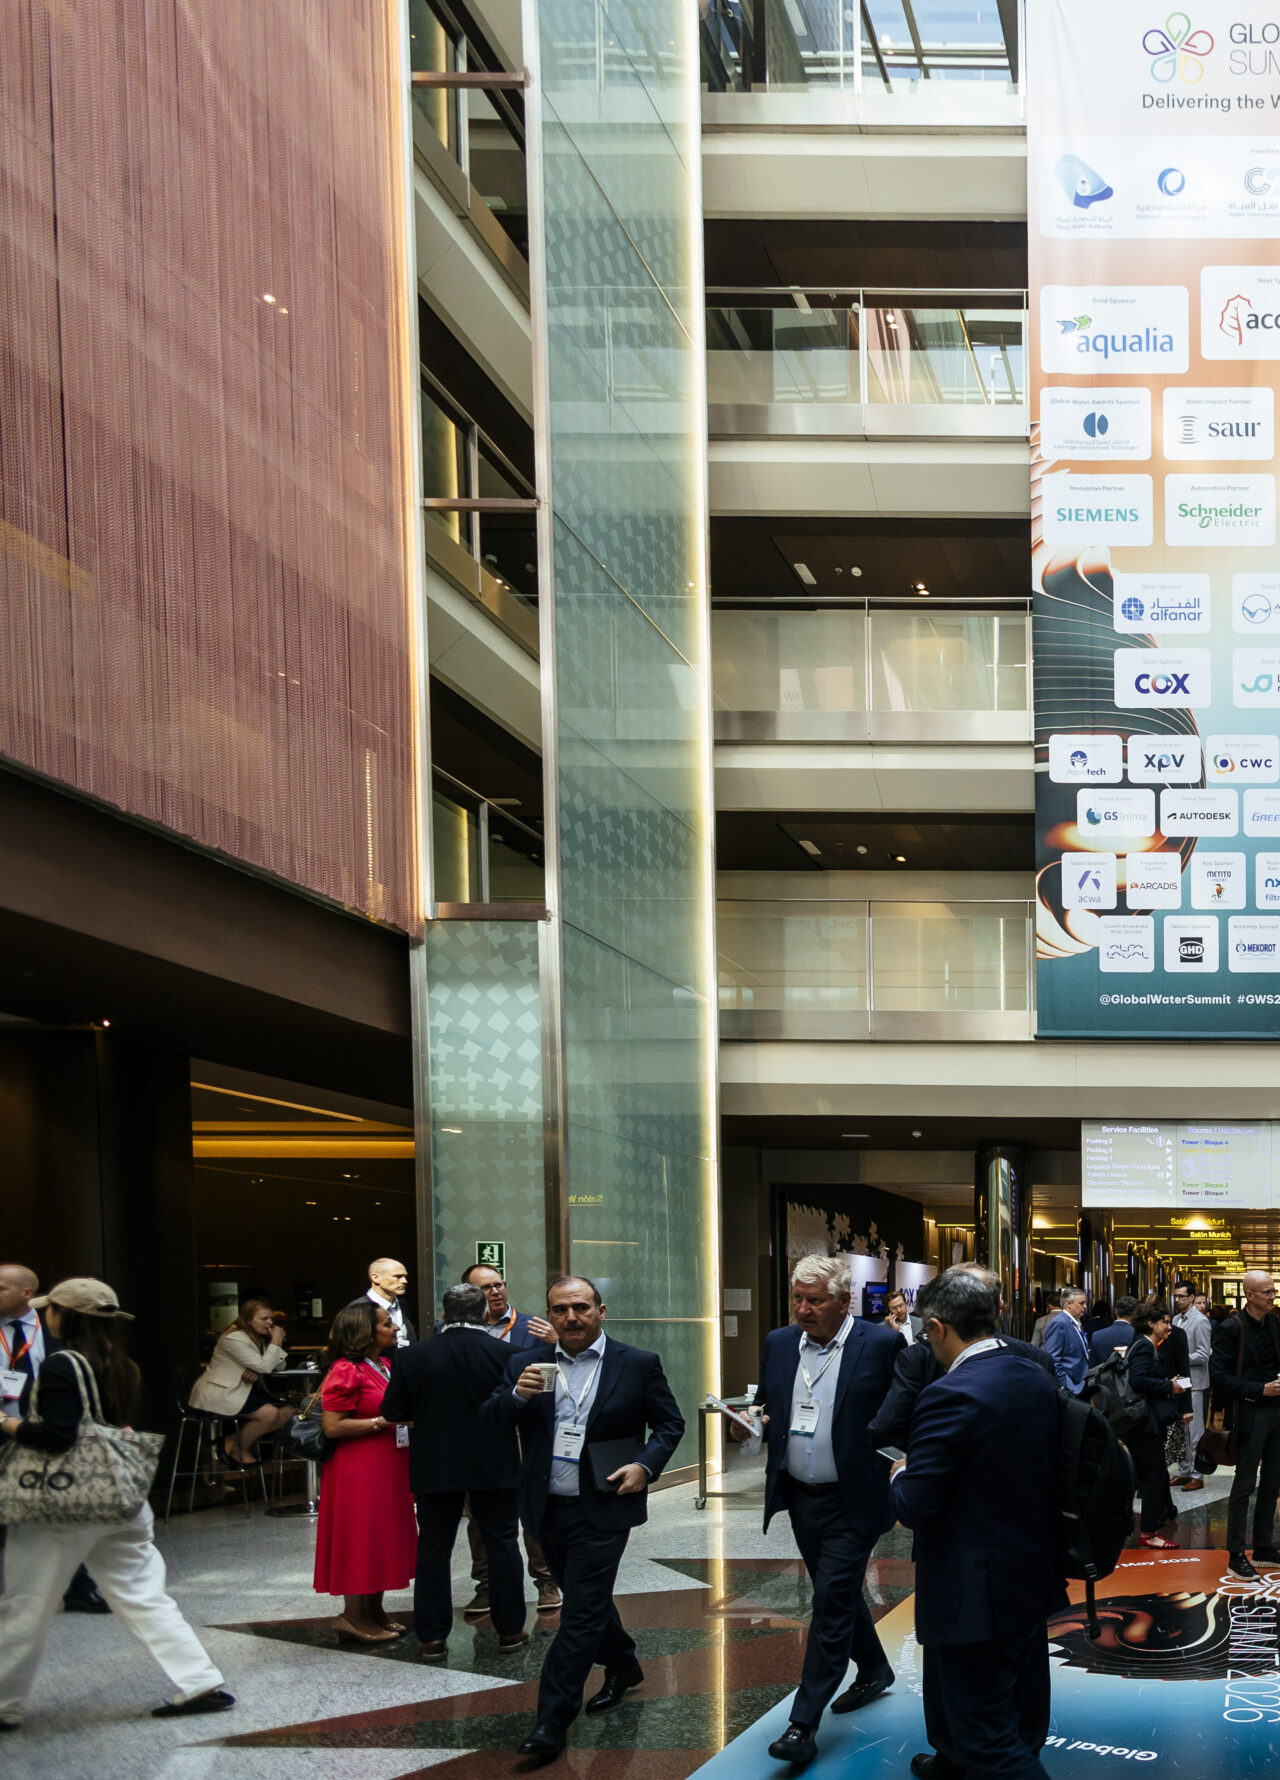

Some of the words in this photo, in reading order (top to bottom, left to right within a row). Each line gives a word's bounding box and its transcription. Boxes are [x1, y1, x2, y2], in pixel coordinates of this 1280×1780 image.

[1142, 93, 1231, 112] Delivering
[1236, 93, 1265, 109] the
[1109, 297, 1136, 305] Sponsor
[1076, 327, 1174, 359] aqualia
[1208, 421, 1261, 438] saur
[1056, 508, 1139, 522] SIEMENS
[1178, 503, 1262, 518] Schneider
[1214, 518, 1260, 527] Electric
[1150, 609, 1203, 622] alfanar
[1134, 673, 1191, 694] COX
[1240, 758, 1273, 769] CWC
[1066, 767, 1106, 777] Aquatech
[1103, 811, 1118, 821] GS
[1119, 811, 1147, 821] Inima
[1179, 812, 1231, 821] AUTODESK
[1206, 870, 1232, 878] METITO
[1139, 882, 1178, 890] ARCADIS
[1078, 895, 1102, 904] acwa
[1179, 945, 1203, 955] GHD
[1099, 993, 1231, 1006] @GlobalWaterSummit
[1101, 1126, 1127, 1134] Service
[1128, 1126, 1159, 1134] Facilities
[1228, 1605, 1280, 1666] SUMMIT
[1066, 1740, 1159, 1762] Global
